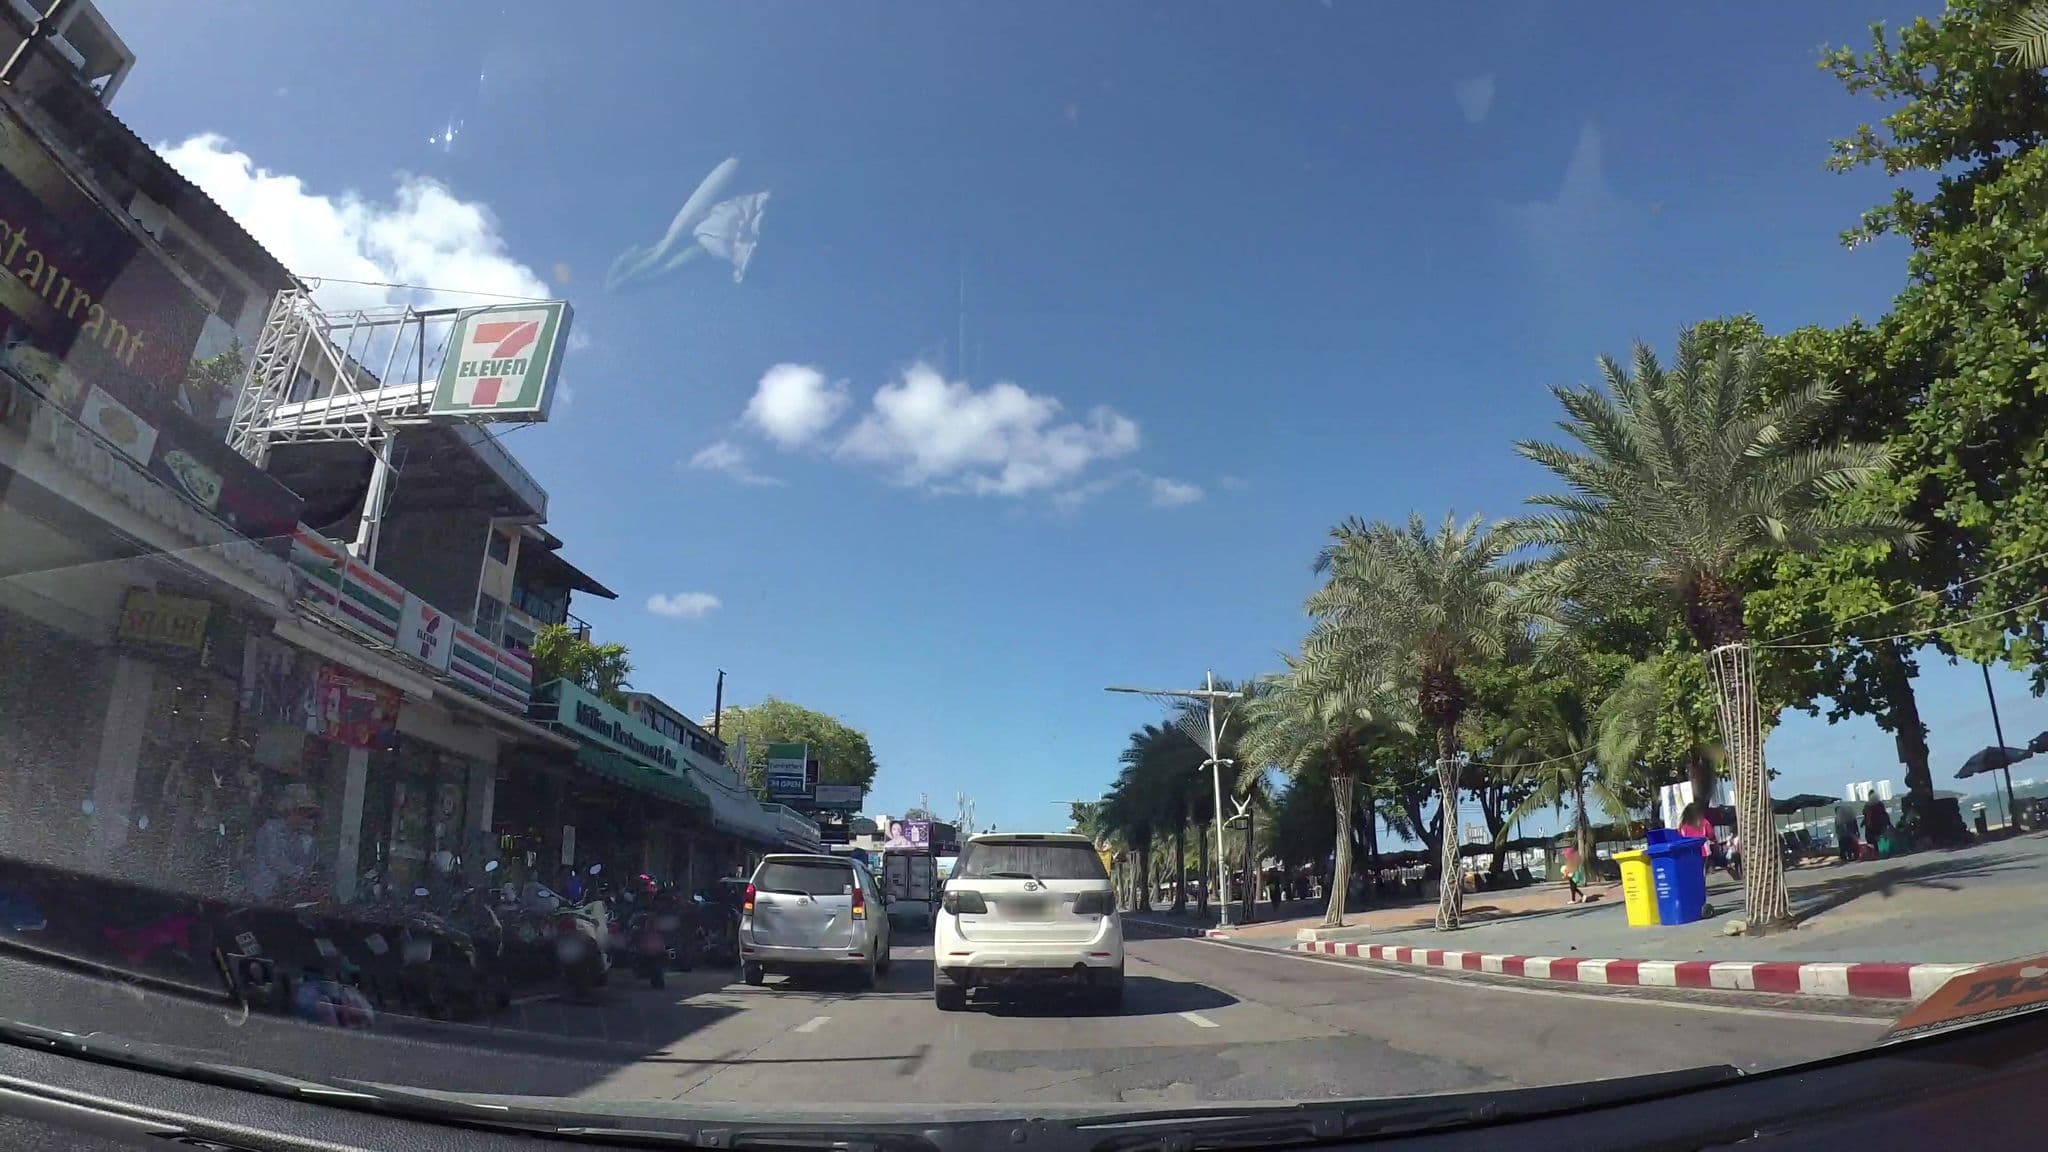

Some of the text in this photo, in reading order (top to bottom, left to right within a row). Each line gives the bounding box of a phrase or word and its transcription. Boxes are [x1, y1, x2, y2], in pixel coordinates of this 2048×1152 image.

[471, 321, 539, 406] 7
[420, 605, 440, 659] 7
[780, 779, 801, 788] OPEN
